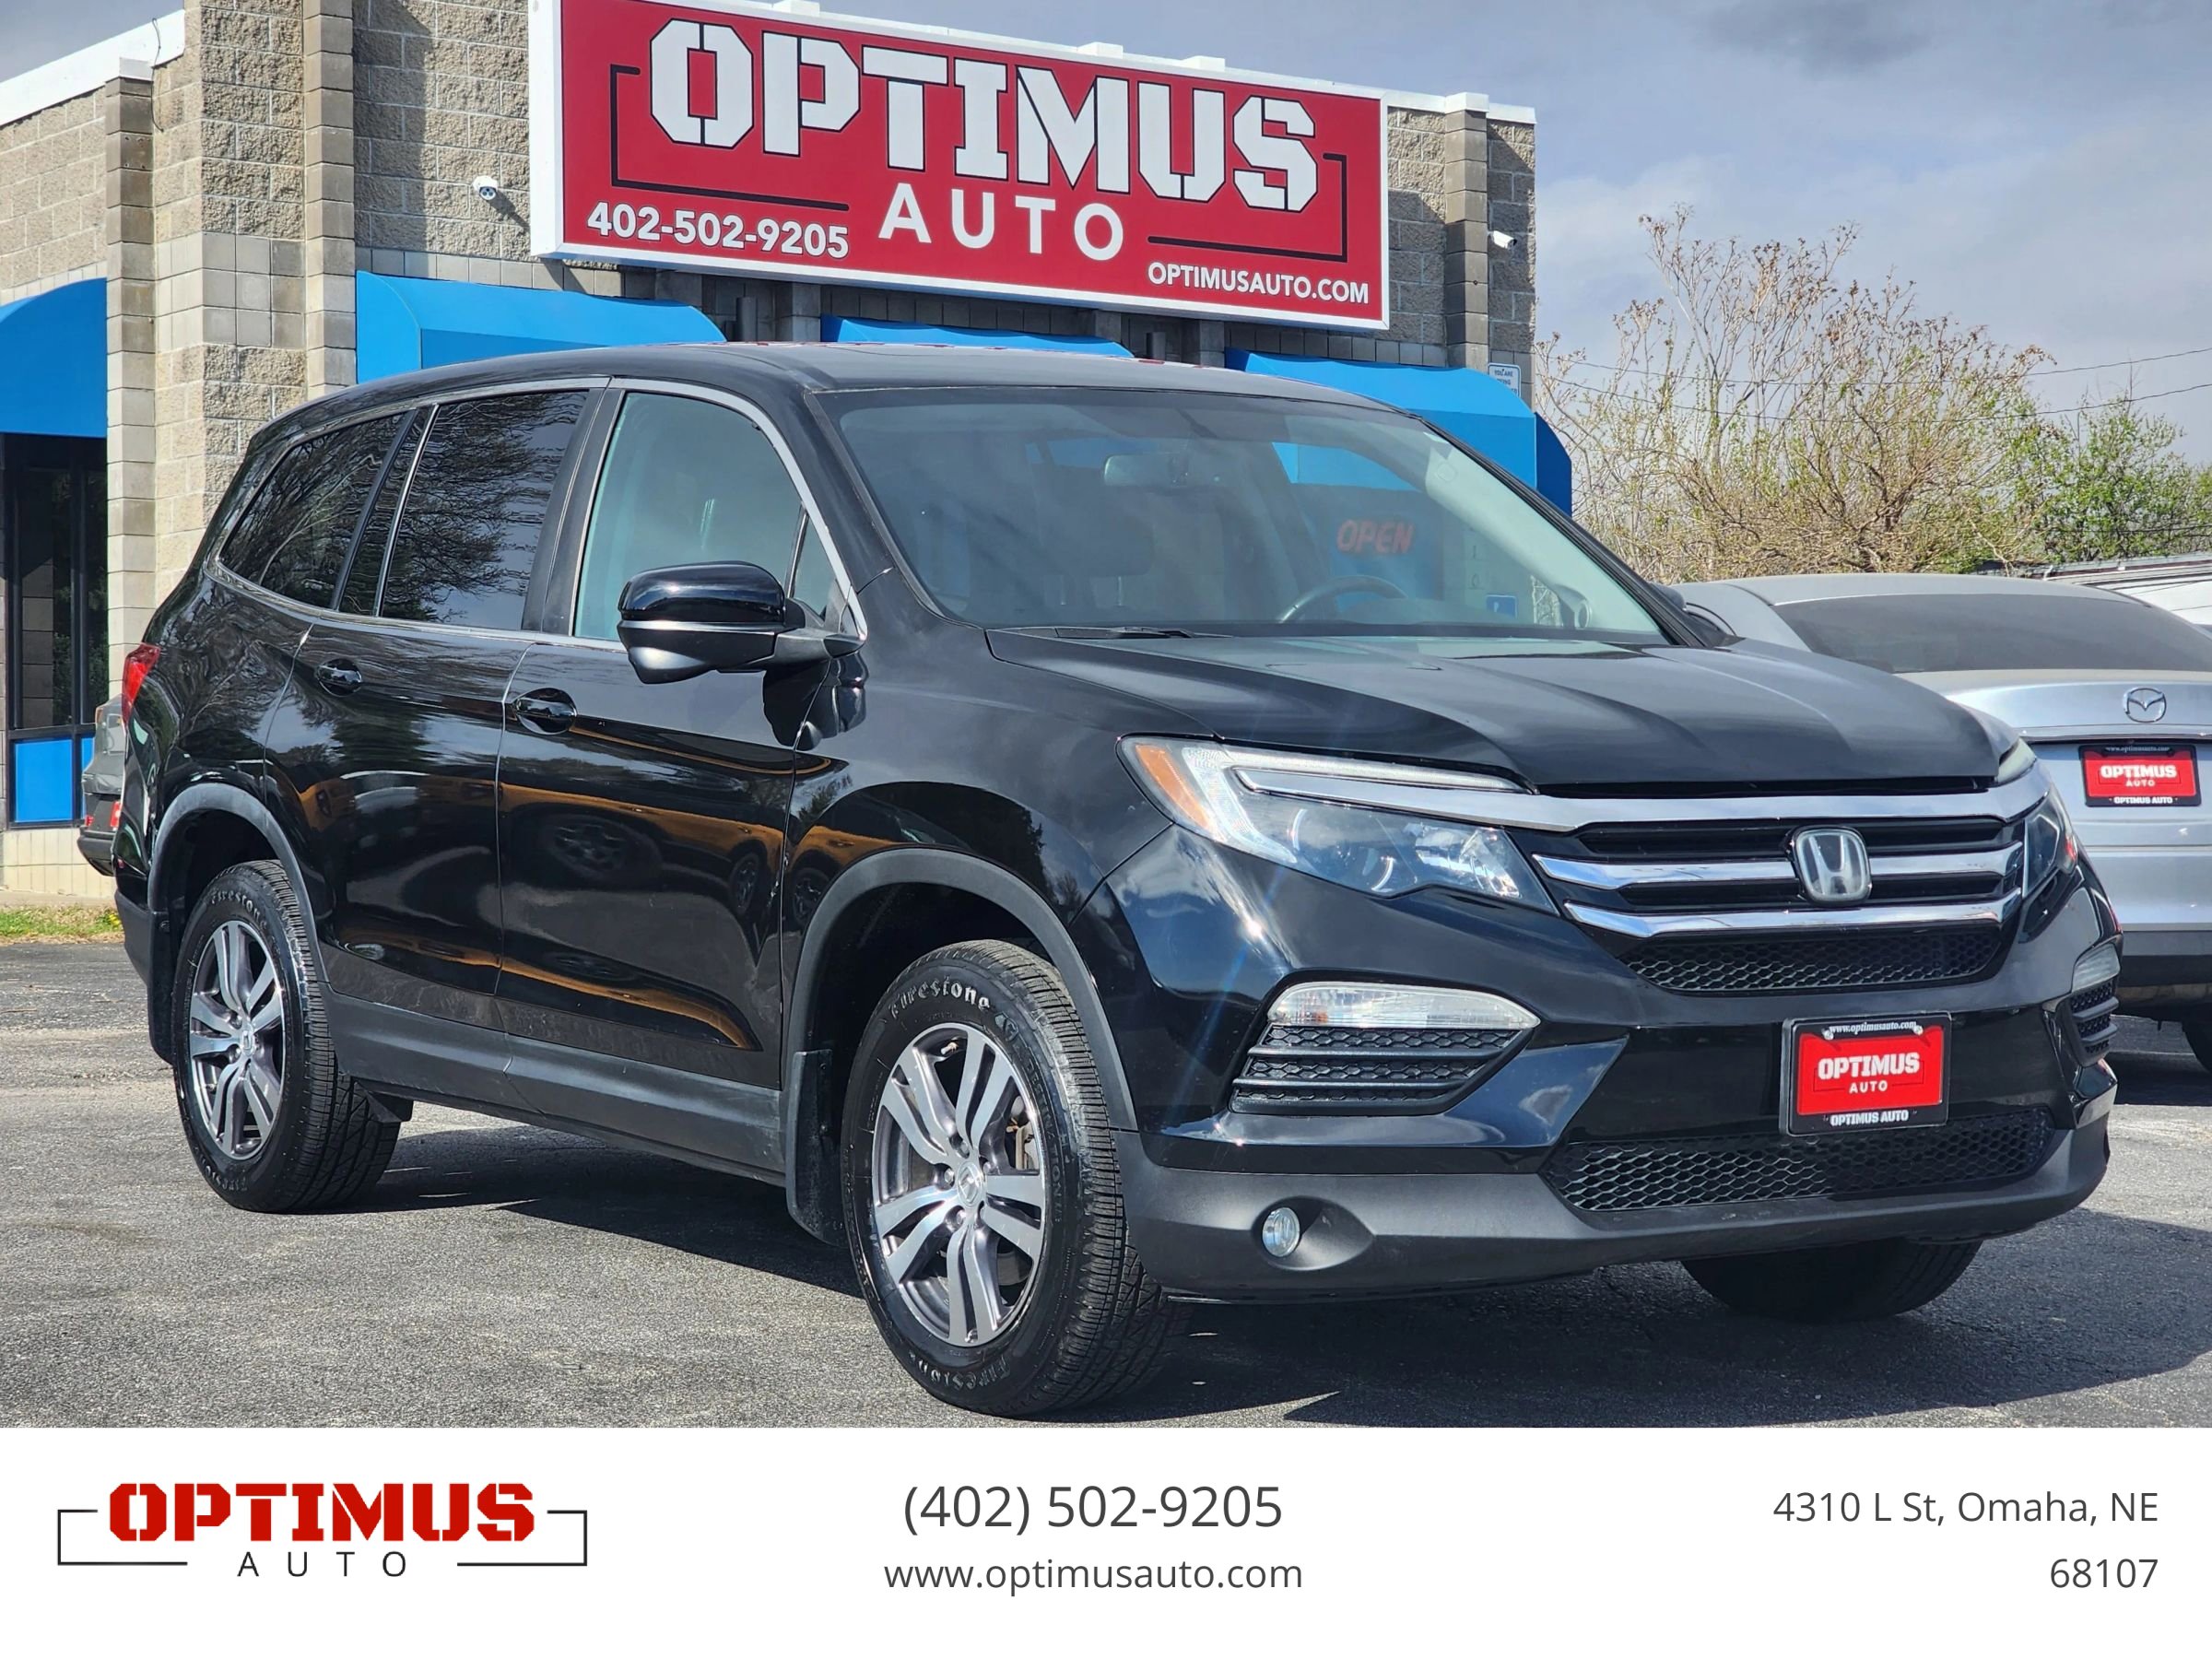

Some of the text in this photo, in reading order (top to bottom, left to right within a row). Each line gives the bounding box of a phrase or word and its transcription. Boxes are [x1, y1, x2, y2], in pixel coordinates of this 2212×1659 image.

[649, 18, 1318, 213] OPTIMUS
[587, 201, 850, 259] 402-502-9205
[877, 182, 1124, 262] AUTO
[1147, 261, 1370, 305] OPTIMUSAUTO.COM
[1336, 519, 1417, 554] OPEN
[2100, 765, 2177, 779] OPTIMUS
[2125, 779, 2156, 787] AUTO
[2113, 796, 2173, 805] OPTIMUS AUTO
[888, 974, 992, 1019] Firestone
[1829, 1020, 1918, 1035] www.optimusauto.com
[1818, 1053, 1921, 1080] OPTIMUS
[1849, 1079, 1888, 1095] AUTO
[1830, 1109, 1910, 1127] OPTIMUS AUTO
